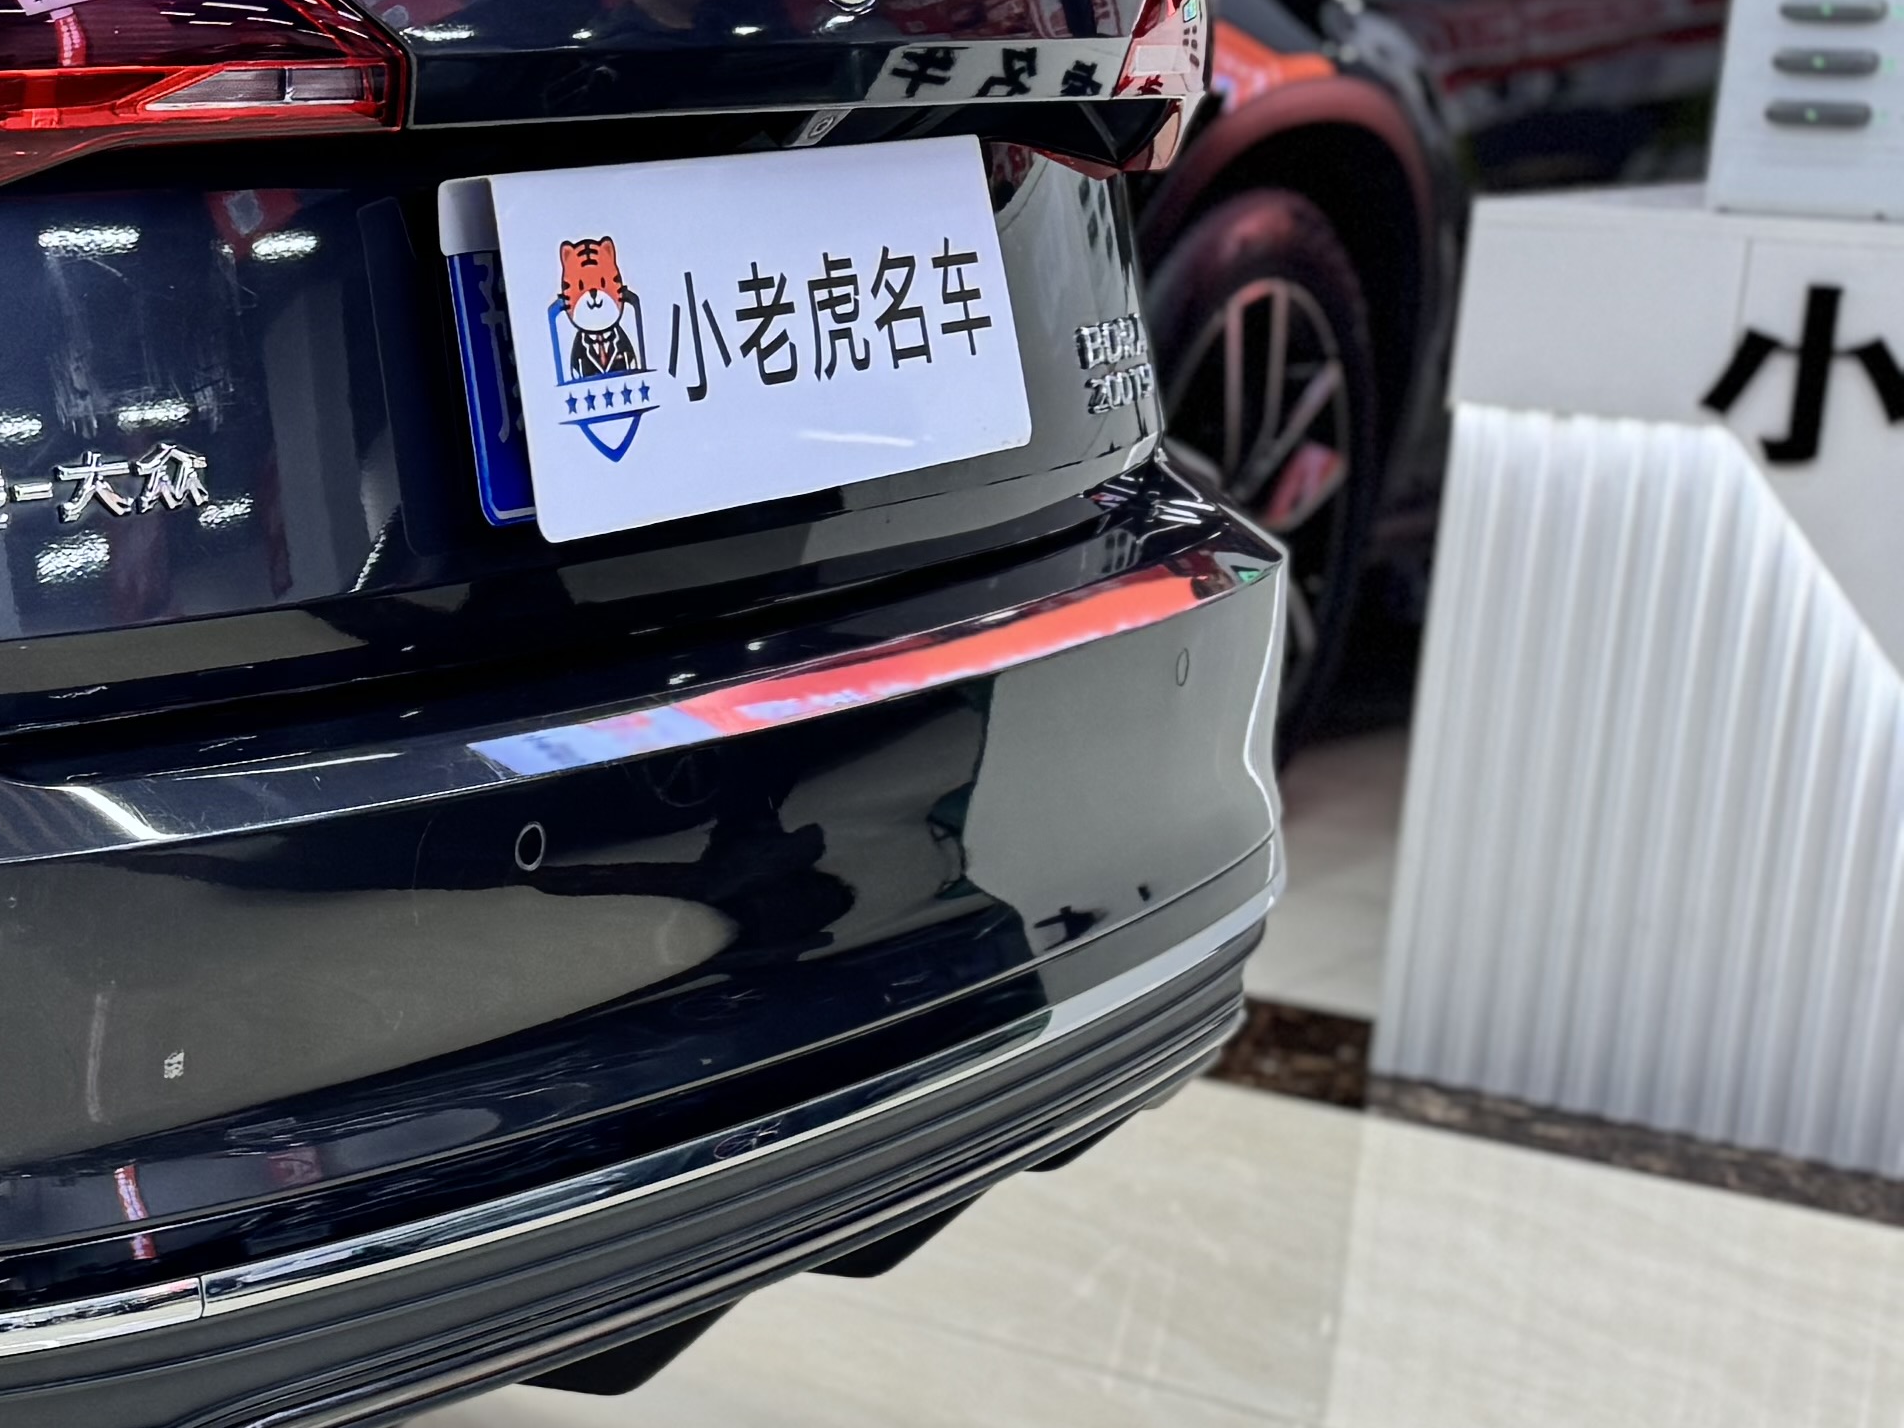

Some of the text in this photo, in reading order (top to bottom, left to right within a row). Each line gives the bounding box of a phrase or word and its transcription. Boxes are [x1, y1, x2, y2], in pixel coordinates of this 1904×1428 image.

[666, 237, 993, 402] 小老虎名车
[1699, 285, 1904, 464] 小
